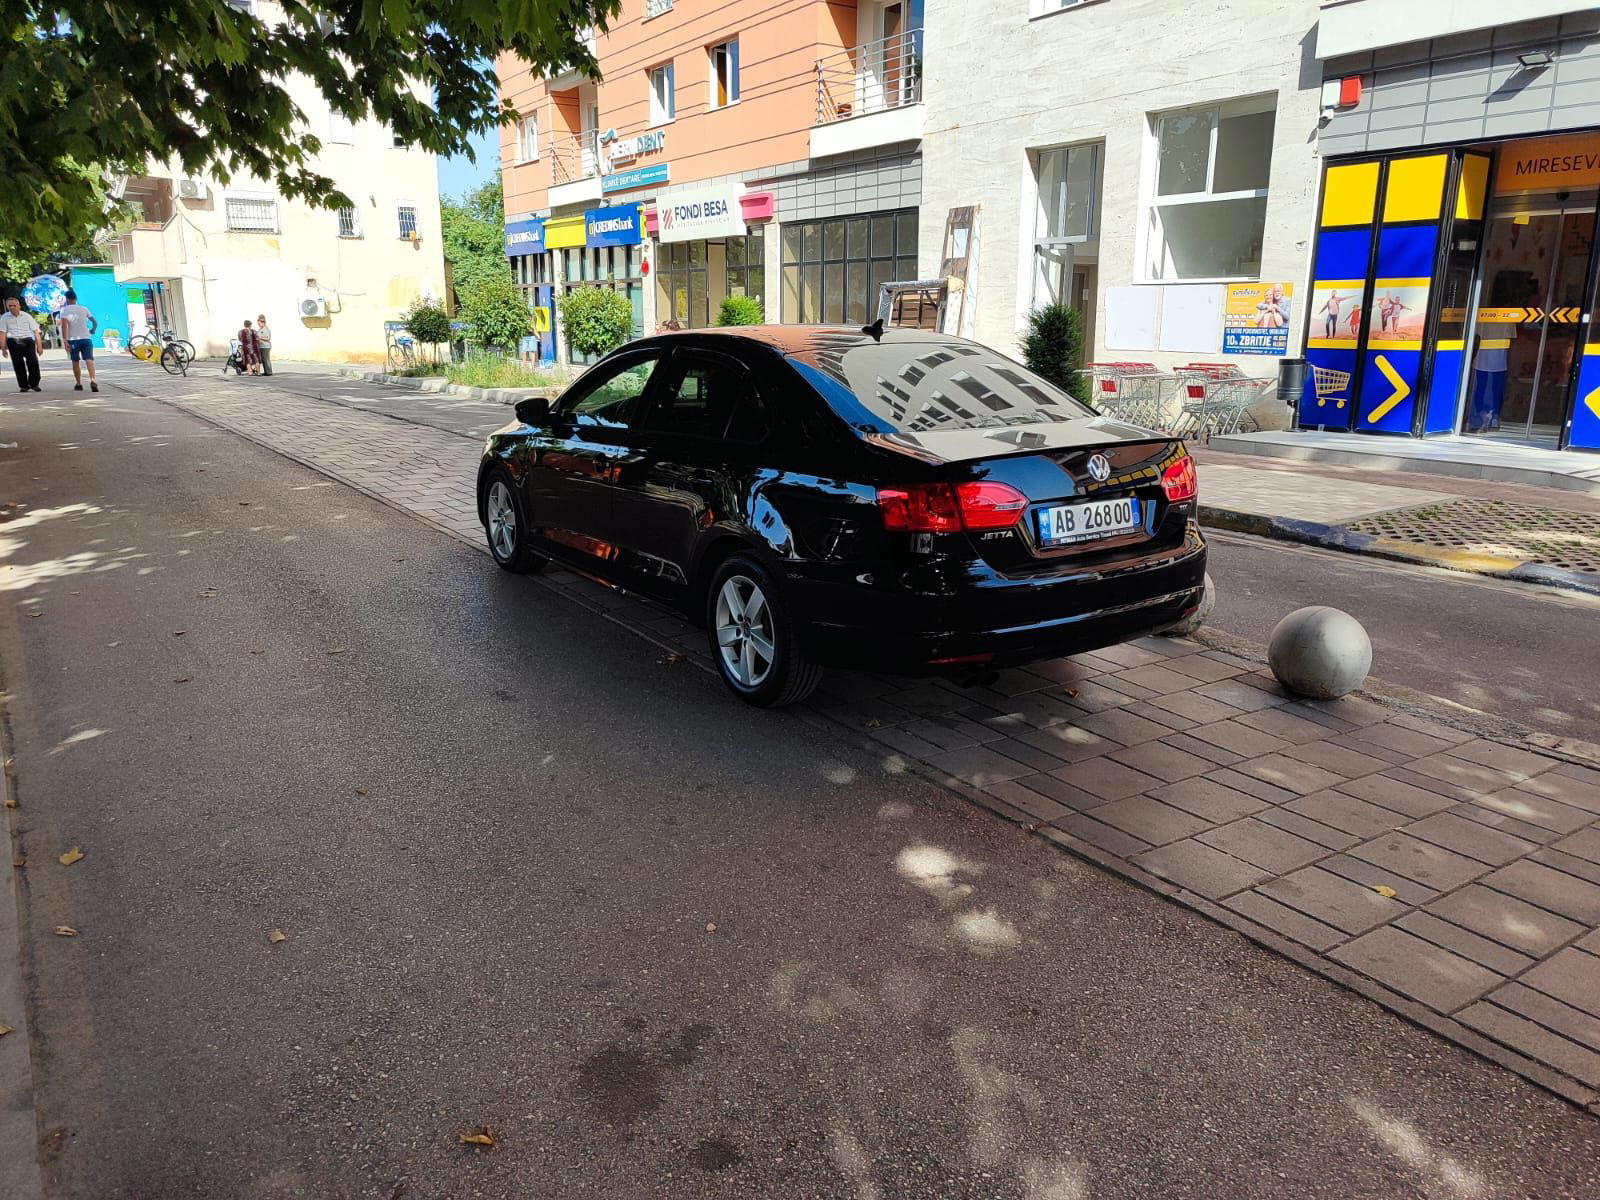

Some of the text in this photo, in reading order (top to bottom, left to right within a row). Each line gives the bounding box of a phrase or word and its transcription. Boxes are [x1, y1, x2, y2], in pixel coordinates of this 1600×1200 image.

[674, 199, 729, 221] FONDI BESA
[1239, 335, 1272, 347] ZBRITJE
[1055, 509, 1075, 534] AB
[980, 530, 1014, 540] JETTA
